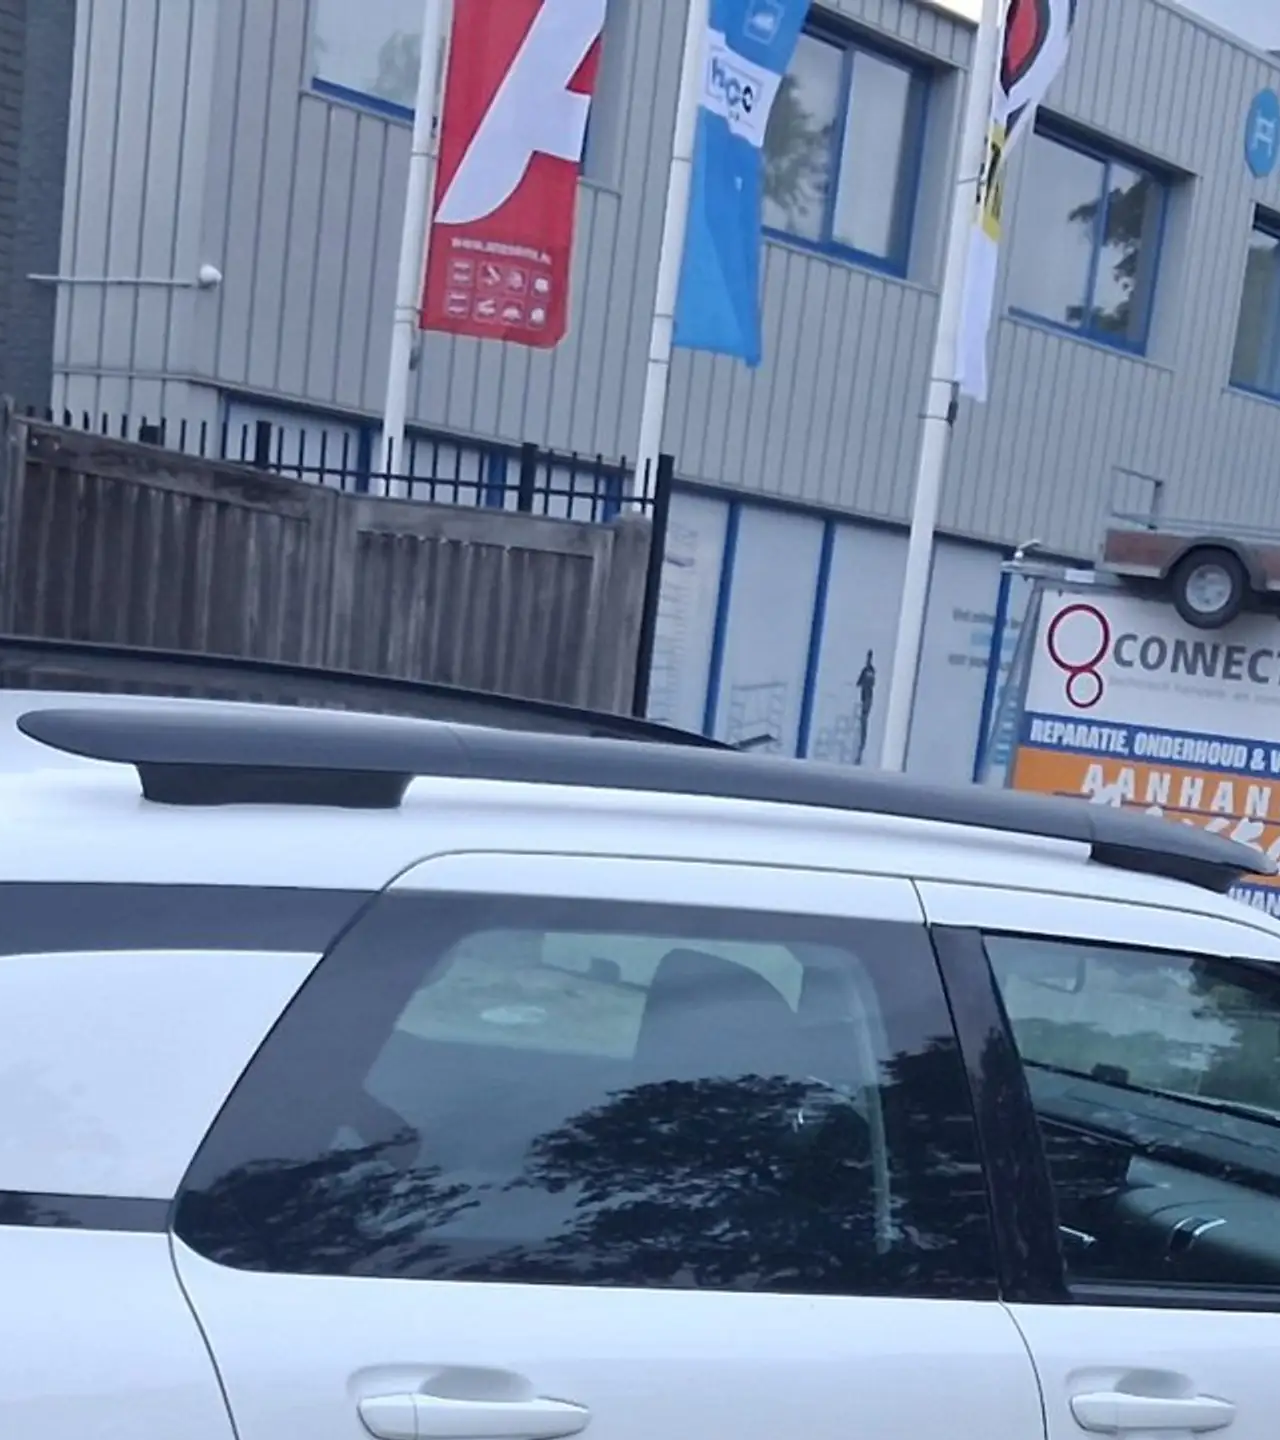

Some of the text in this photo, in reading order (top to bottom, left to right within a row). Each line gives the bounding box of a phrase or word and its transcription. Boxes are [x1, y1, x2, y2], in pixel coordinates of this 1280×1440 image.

[1030, 717, 1130, 755] REPARATIE,
[1133, 731, 1248, 769] ONDERHOUD
[1250, 748, 1267, 771] &
